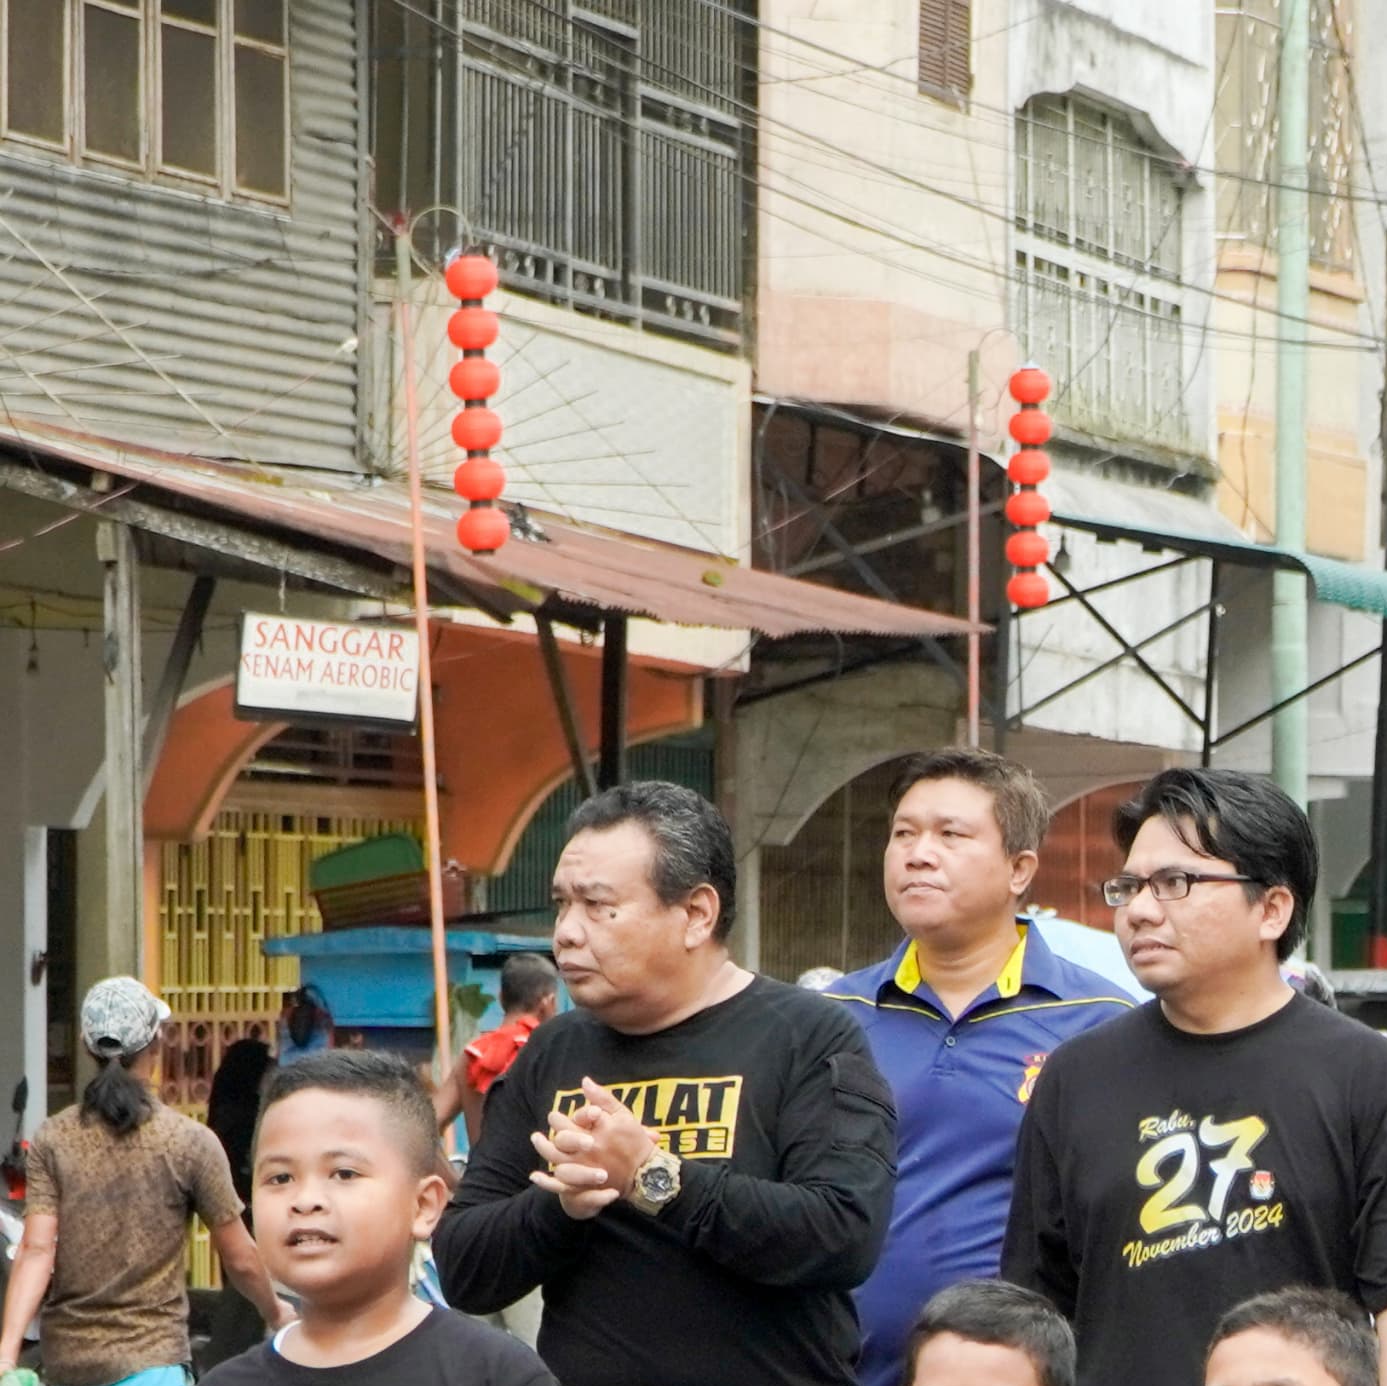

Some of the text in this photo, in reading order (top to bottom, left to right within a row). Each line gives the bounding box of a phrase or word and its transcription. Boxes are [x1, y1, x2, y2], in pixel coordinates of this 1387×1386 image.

[255, 620, 405, 662] SANGGAR
[241, 653, 415, 692] SENAM AEROBIC
[558, 1081, 735, 1126] KLAT
[1136, 1115, 1269, 1234] 27
[1122, 1203, 1284, 1268] November 2024
